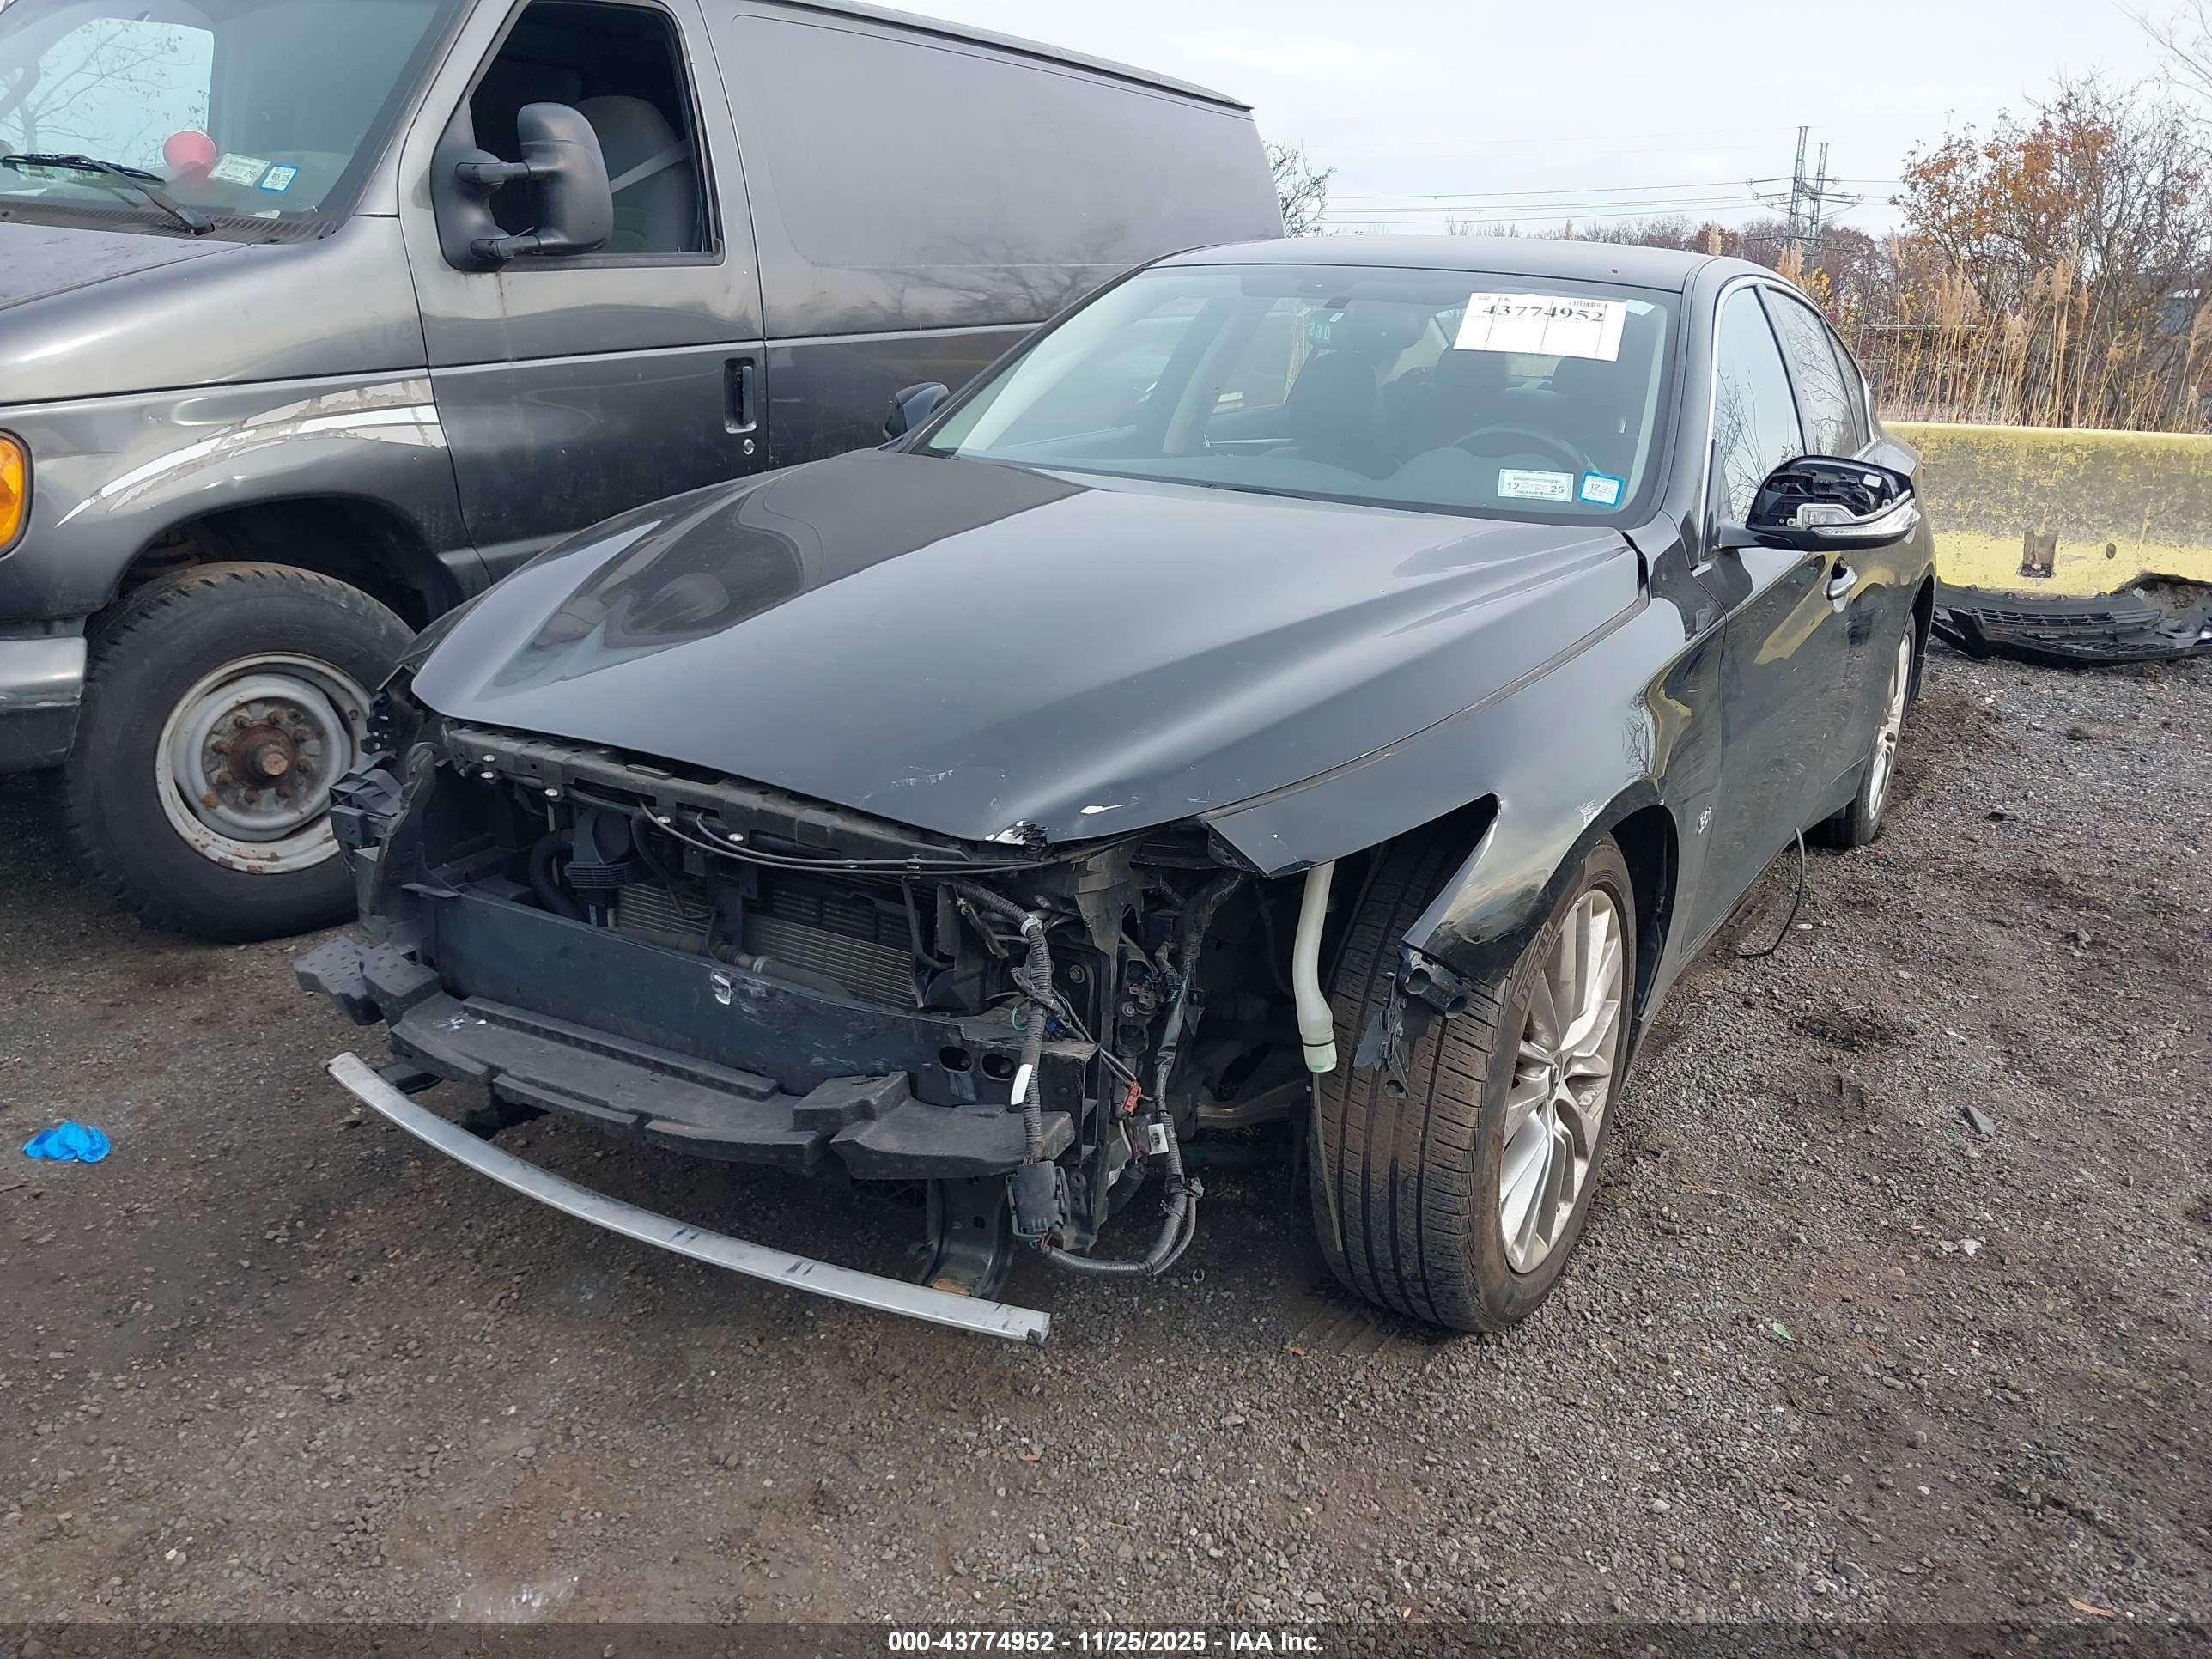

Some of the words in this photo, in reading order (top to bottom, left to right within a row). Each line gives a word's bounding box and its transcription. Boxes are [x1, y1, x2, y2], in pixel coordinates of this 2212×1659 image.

[1481, 304, 1605, 323] 43774952
[1308, 322, 1331, 341] 230
[1506, 482, 1520, 490] 12
[1550, 485, 1565, 494] 25
